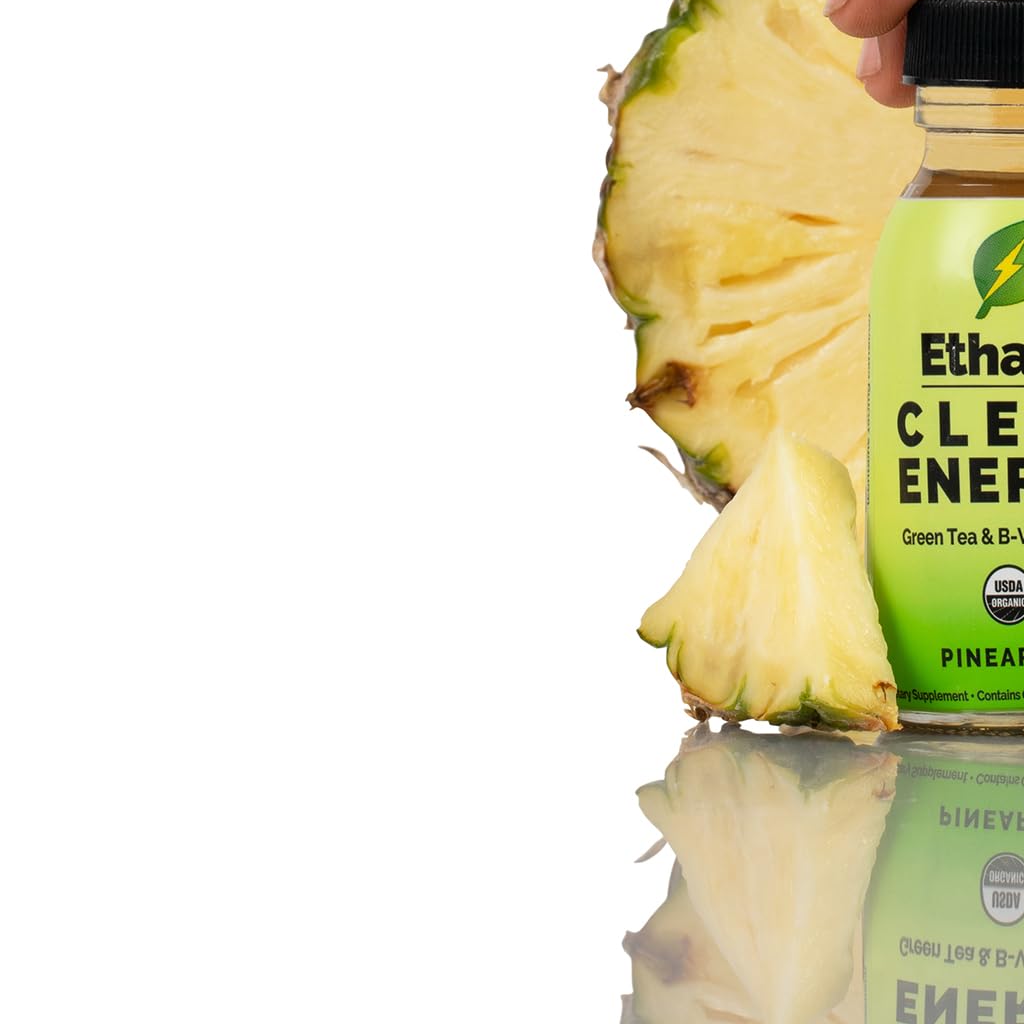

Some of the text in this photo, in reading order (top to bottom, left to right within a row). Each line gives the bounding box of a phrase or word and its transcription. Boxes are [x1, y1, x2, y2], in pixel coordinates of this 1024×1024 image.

[902, 527, 944, 546] Green
[947, 527, 978, 545] Tea
[982, 528, 994, 545] &
[994, 579, 1024, 593] USDA
[912, 688, 969, 703] Supplement
[977, 689, 1021, 702] Contains
